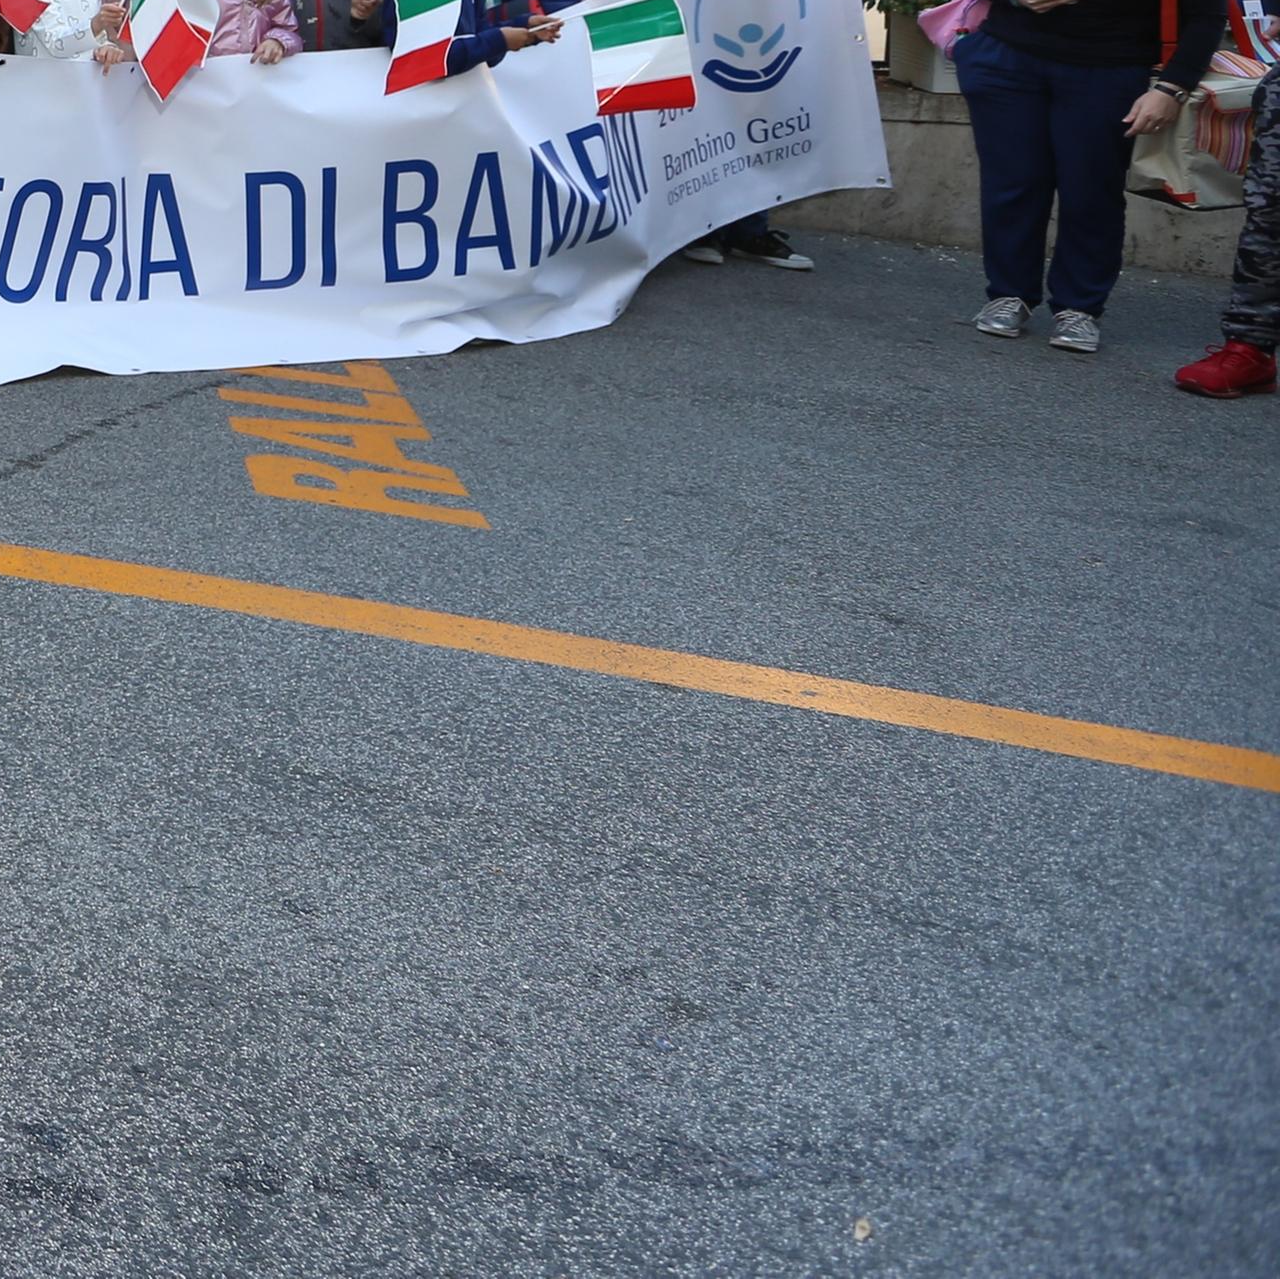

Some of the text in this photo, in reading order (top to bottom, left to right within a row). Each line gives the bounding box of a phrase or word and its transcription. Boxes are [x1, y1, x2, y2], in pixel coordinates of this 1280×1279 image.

[662, 106, 811, 182] Bambino Gesù
[667, 138, 813, 207] OSPEDALE PEDIATRICO
[244, 166, 337, 292] DI
